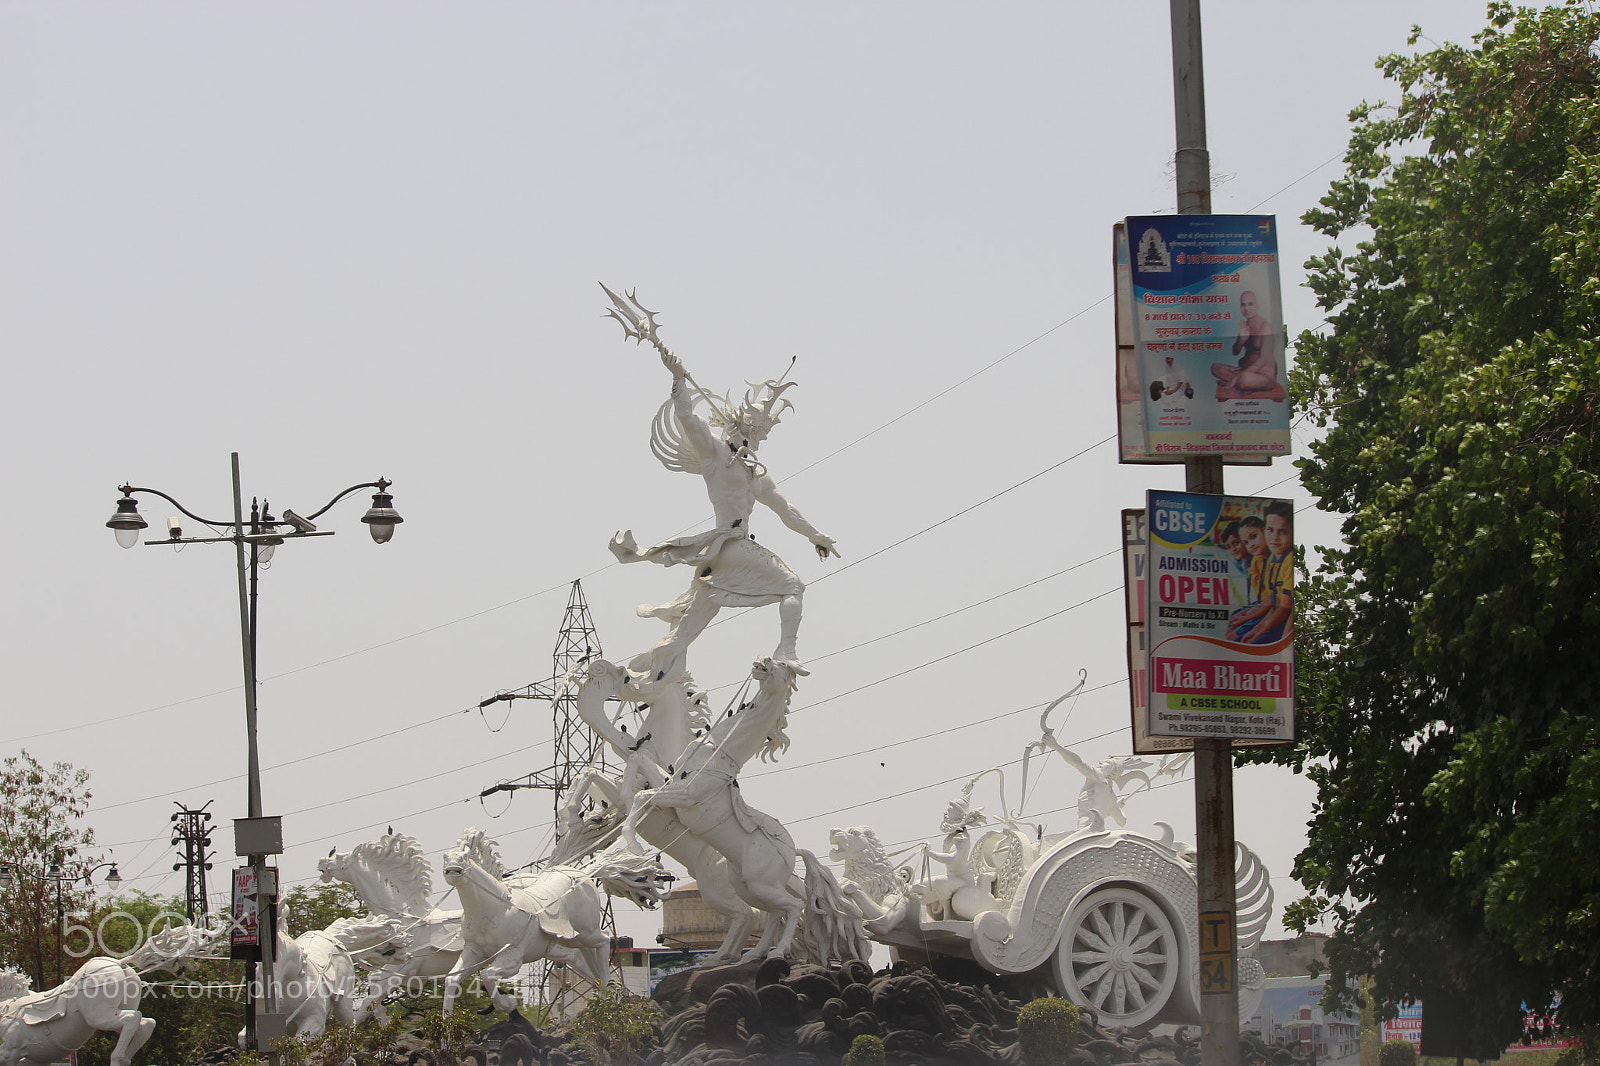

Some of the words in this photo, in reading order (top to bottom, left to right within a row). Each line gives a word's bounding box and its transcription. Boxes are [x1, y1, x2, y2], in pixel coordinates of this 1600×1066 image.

[1143, 292, 1177, 304] विशाल
[1178, 292, 1203, 304] शोभा
[1205, 295, 1228, 304] यात्रा
[1155, 509, 1206, 533] CBSE
[1159, 556, 1229, 573] ADMISSION
[1159, 574, 1230, 606] OPEN
[1162, 663, 1208, 689] Maa
[1213, 664, 1281, 692] Bharti
[1181, 698, 1188, 707] A
[1190, 698, 1217, 708] CBSE
[1220, 699, 1262, 710] SCHOOL
[1158, 712, 1181, 721] Swami
